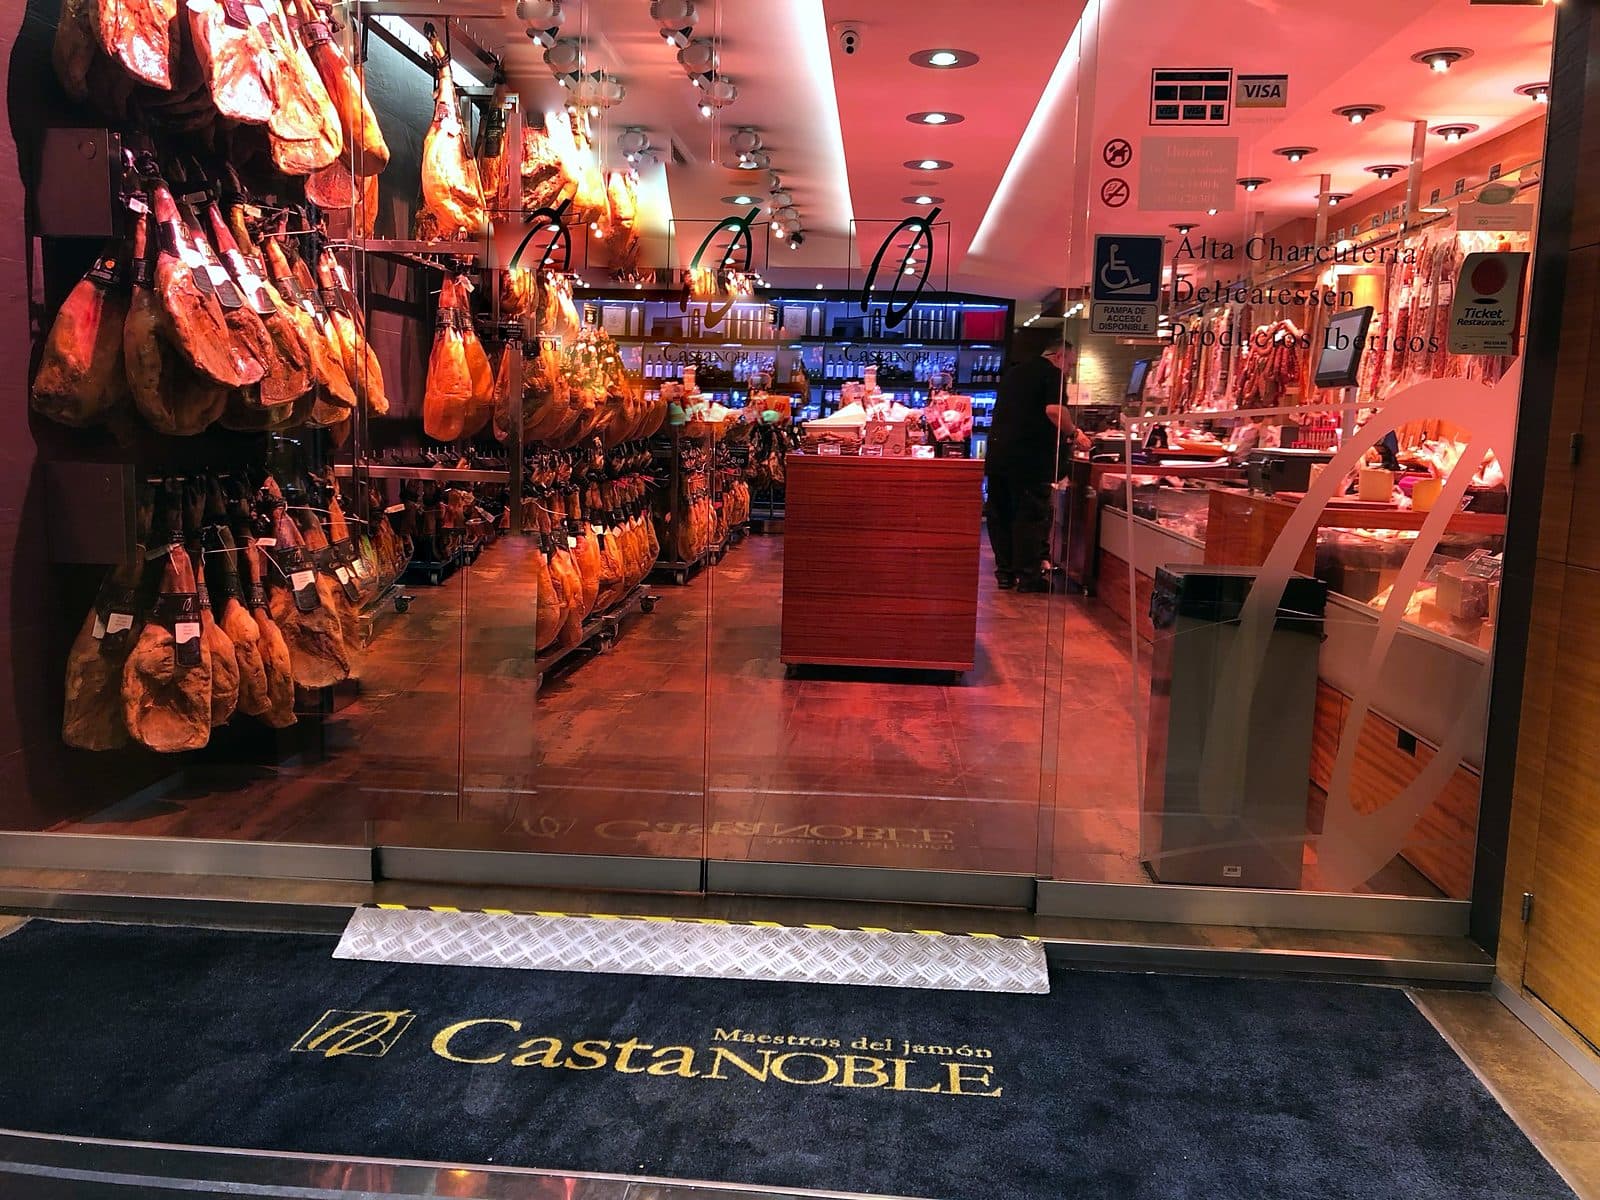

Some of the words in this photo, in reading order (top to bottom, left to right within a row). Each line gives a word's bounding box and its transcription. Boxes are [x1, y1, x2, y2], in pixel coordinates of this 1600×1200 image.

[1244, 84, 1281, 98] VISA
[1174, 236, 1234, 260] Alta
[1246, 237, 1416, 264] Charcutería
[1173, 279, 1354, 307] Delicatessen
[1104, 306, 1133, 314] RAMPA
[1134, 306, 1148, 315] DE
[1464, 307, 1504, 319] Ticket
[1098, 322, 1150, 331] DISPONIBLE
[1456, 319, 1506, 327] Restaurant
[1169, 323, 1311, 350] Productos
[711, 1027, 841, 1049] Maestros
[851, 1036, 892, 1052] del
[902, 1040, 993, 1059] jamón
